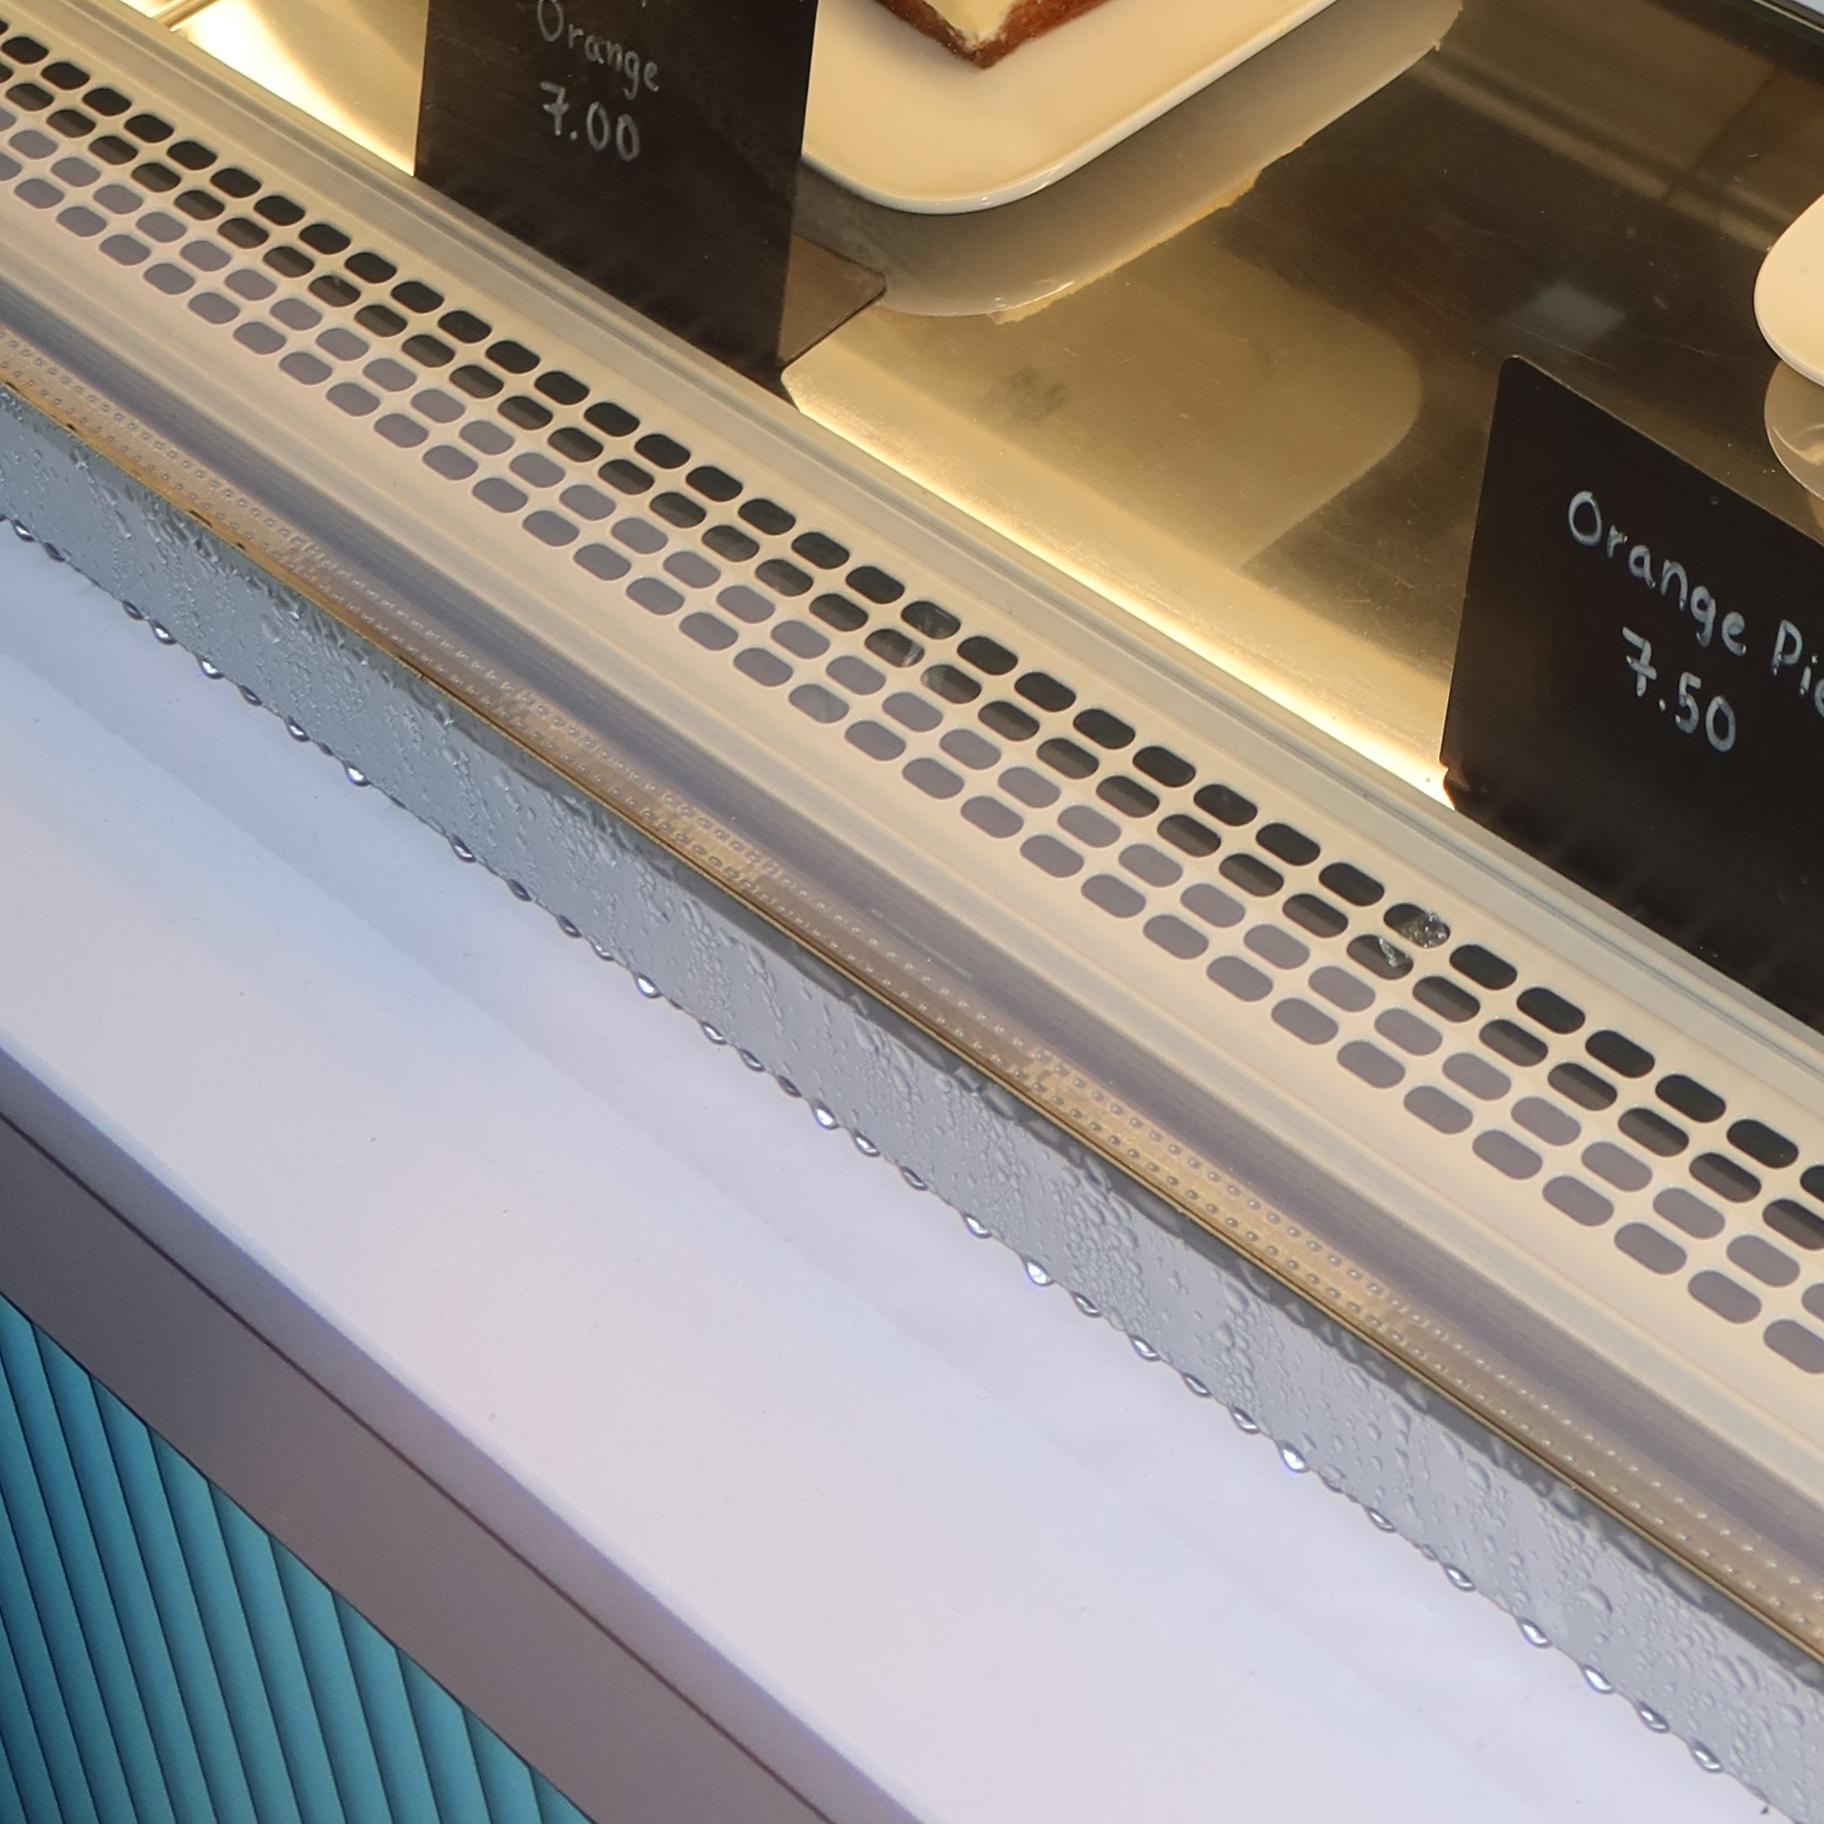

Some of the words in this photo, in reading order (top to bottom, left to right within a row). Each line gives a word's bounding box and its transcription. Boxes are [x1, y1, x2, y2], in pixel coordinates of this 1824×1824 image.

[543, 82, 638, 160] 7.00
[1570, 492, 1745, 654] Orange
[1624, 628, 1736, 751] 7.50
